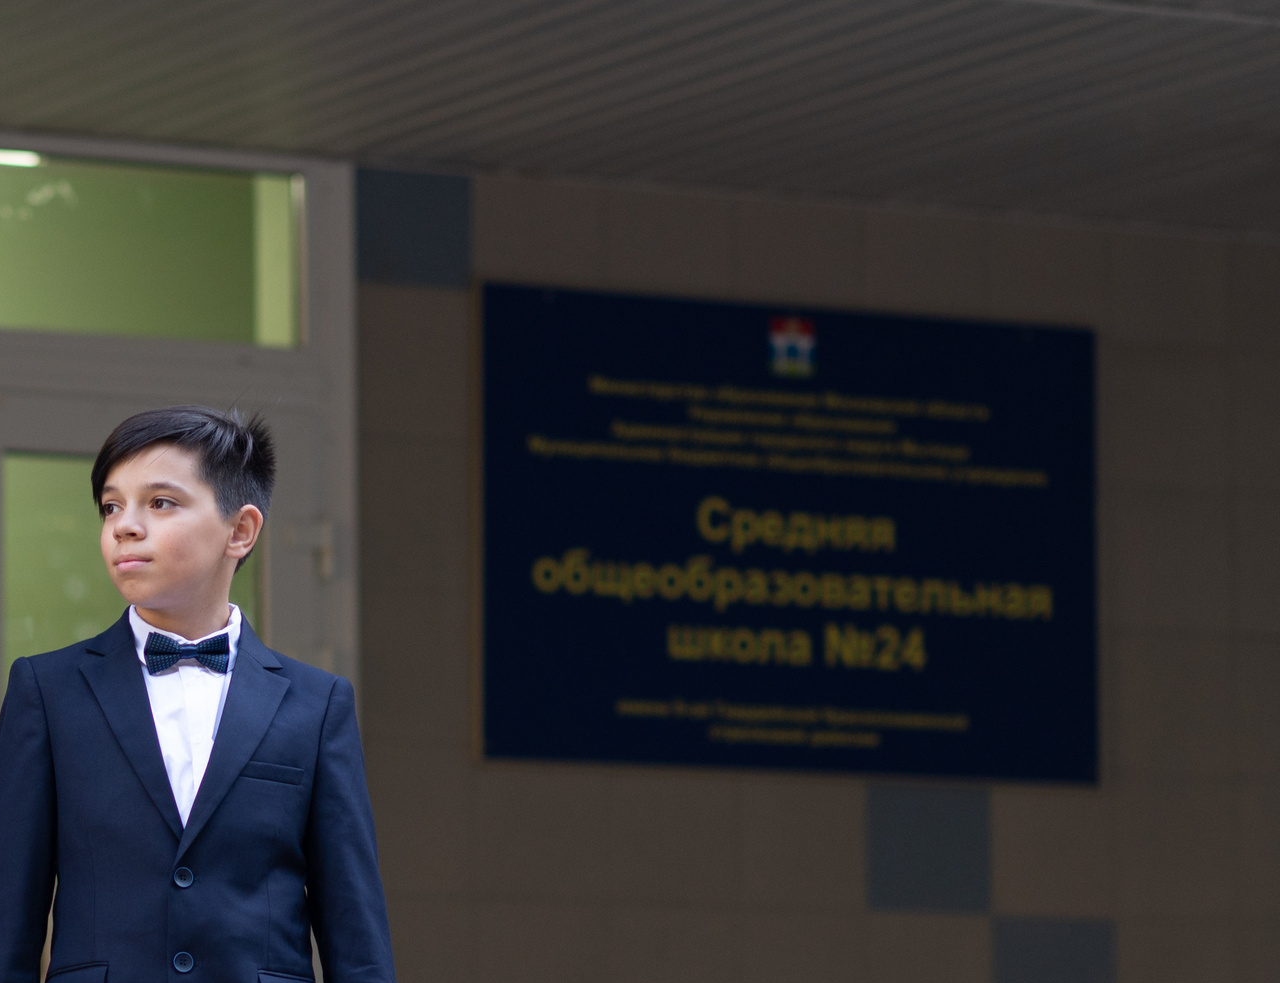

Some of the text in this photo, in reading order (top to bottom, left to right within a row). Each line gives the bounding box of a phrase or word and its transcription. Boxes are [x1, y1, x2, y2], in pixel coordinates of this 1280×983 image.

[697, 497, 896, 553] Средняя
[532, 549, 1053, 620] общеобразовательная
[667, 621, 926, 671] школа №24
